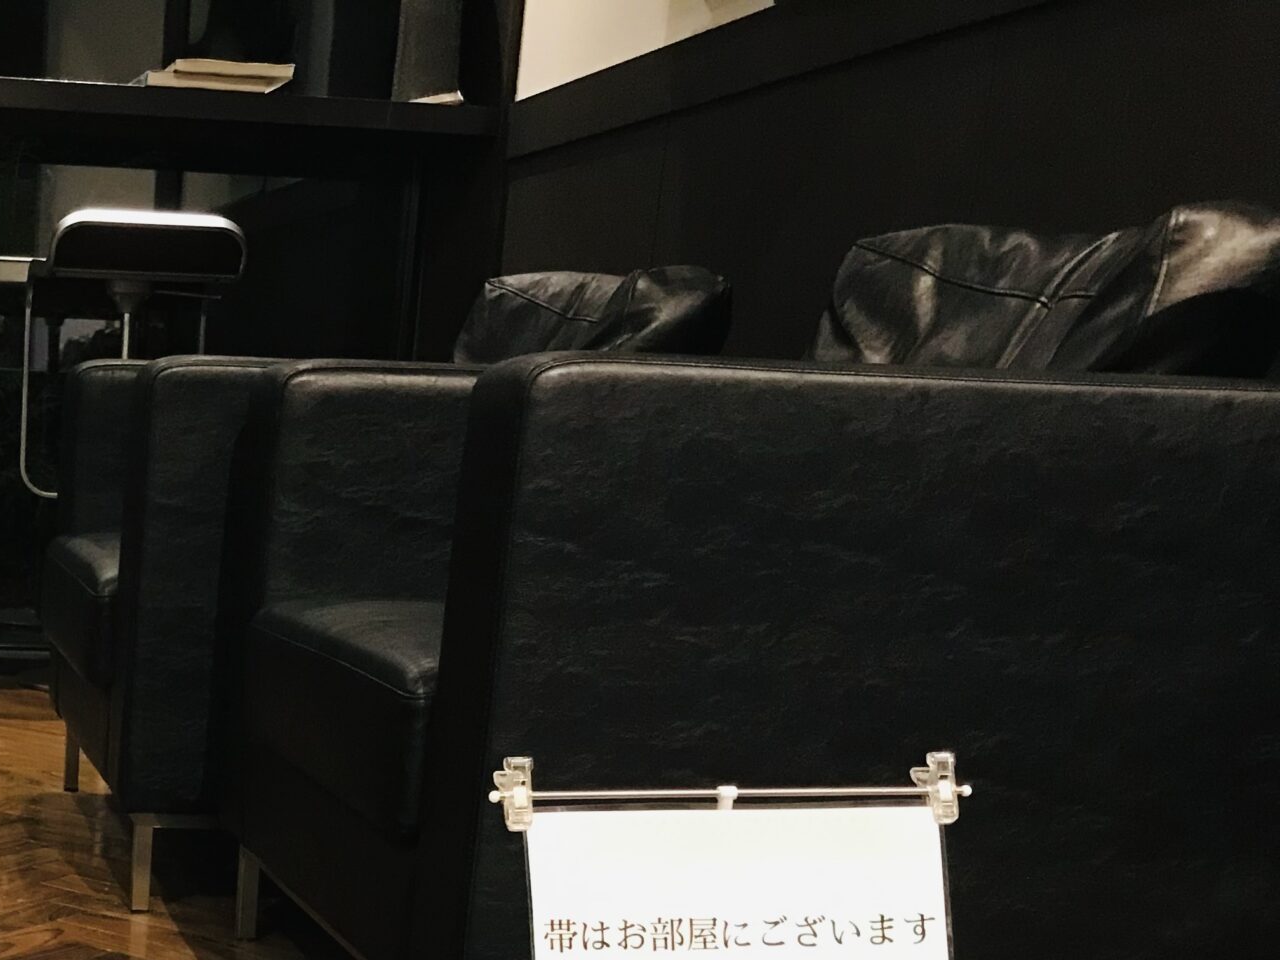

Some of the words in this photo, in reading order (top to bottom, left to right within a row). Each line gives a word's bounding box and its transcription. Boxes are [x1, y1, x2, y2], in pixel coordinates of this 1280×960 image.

[544, 913, 936, 953] 帯はお部屋にございます
